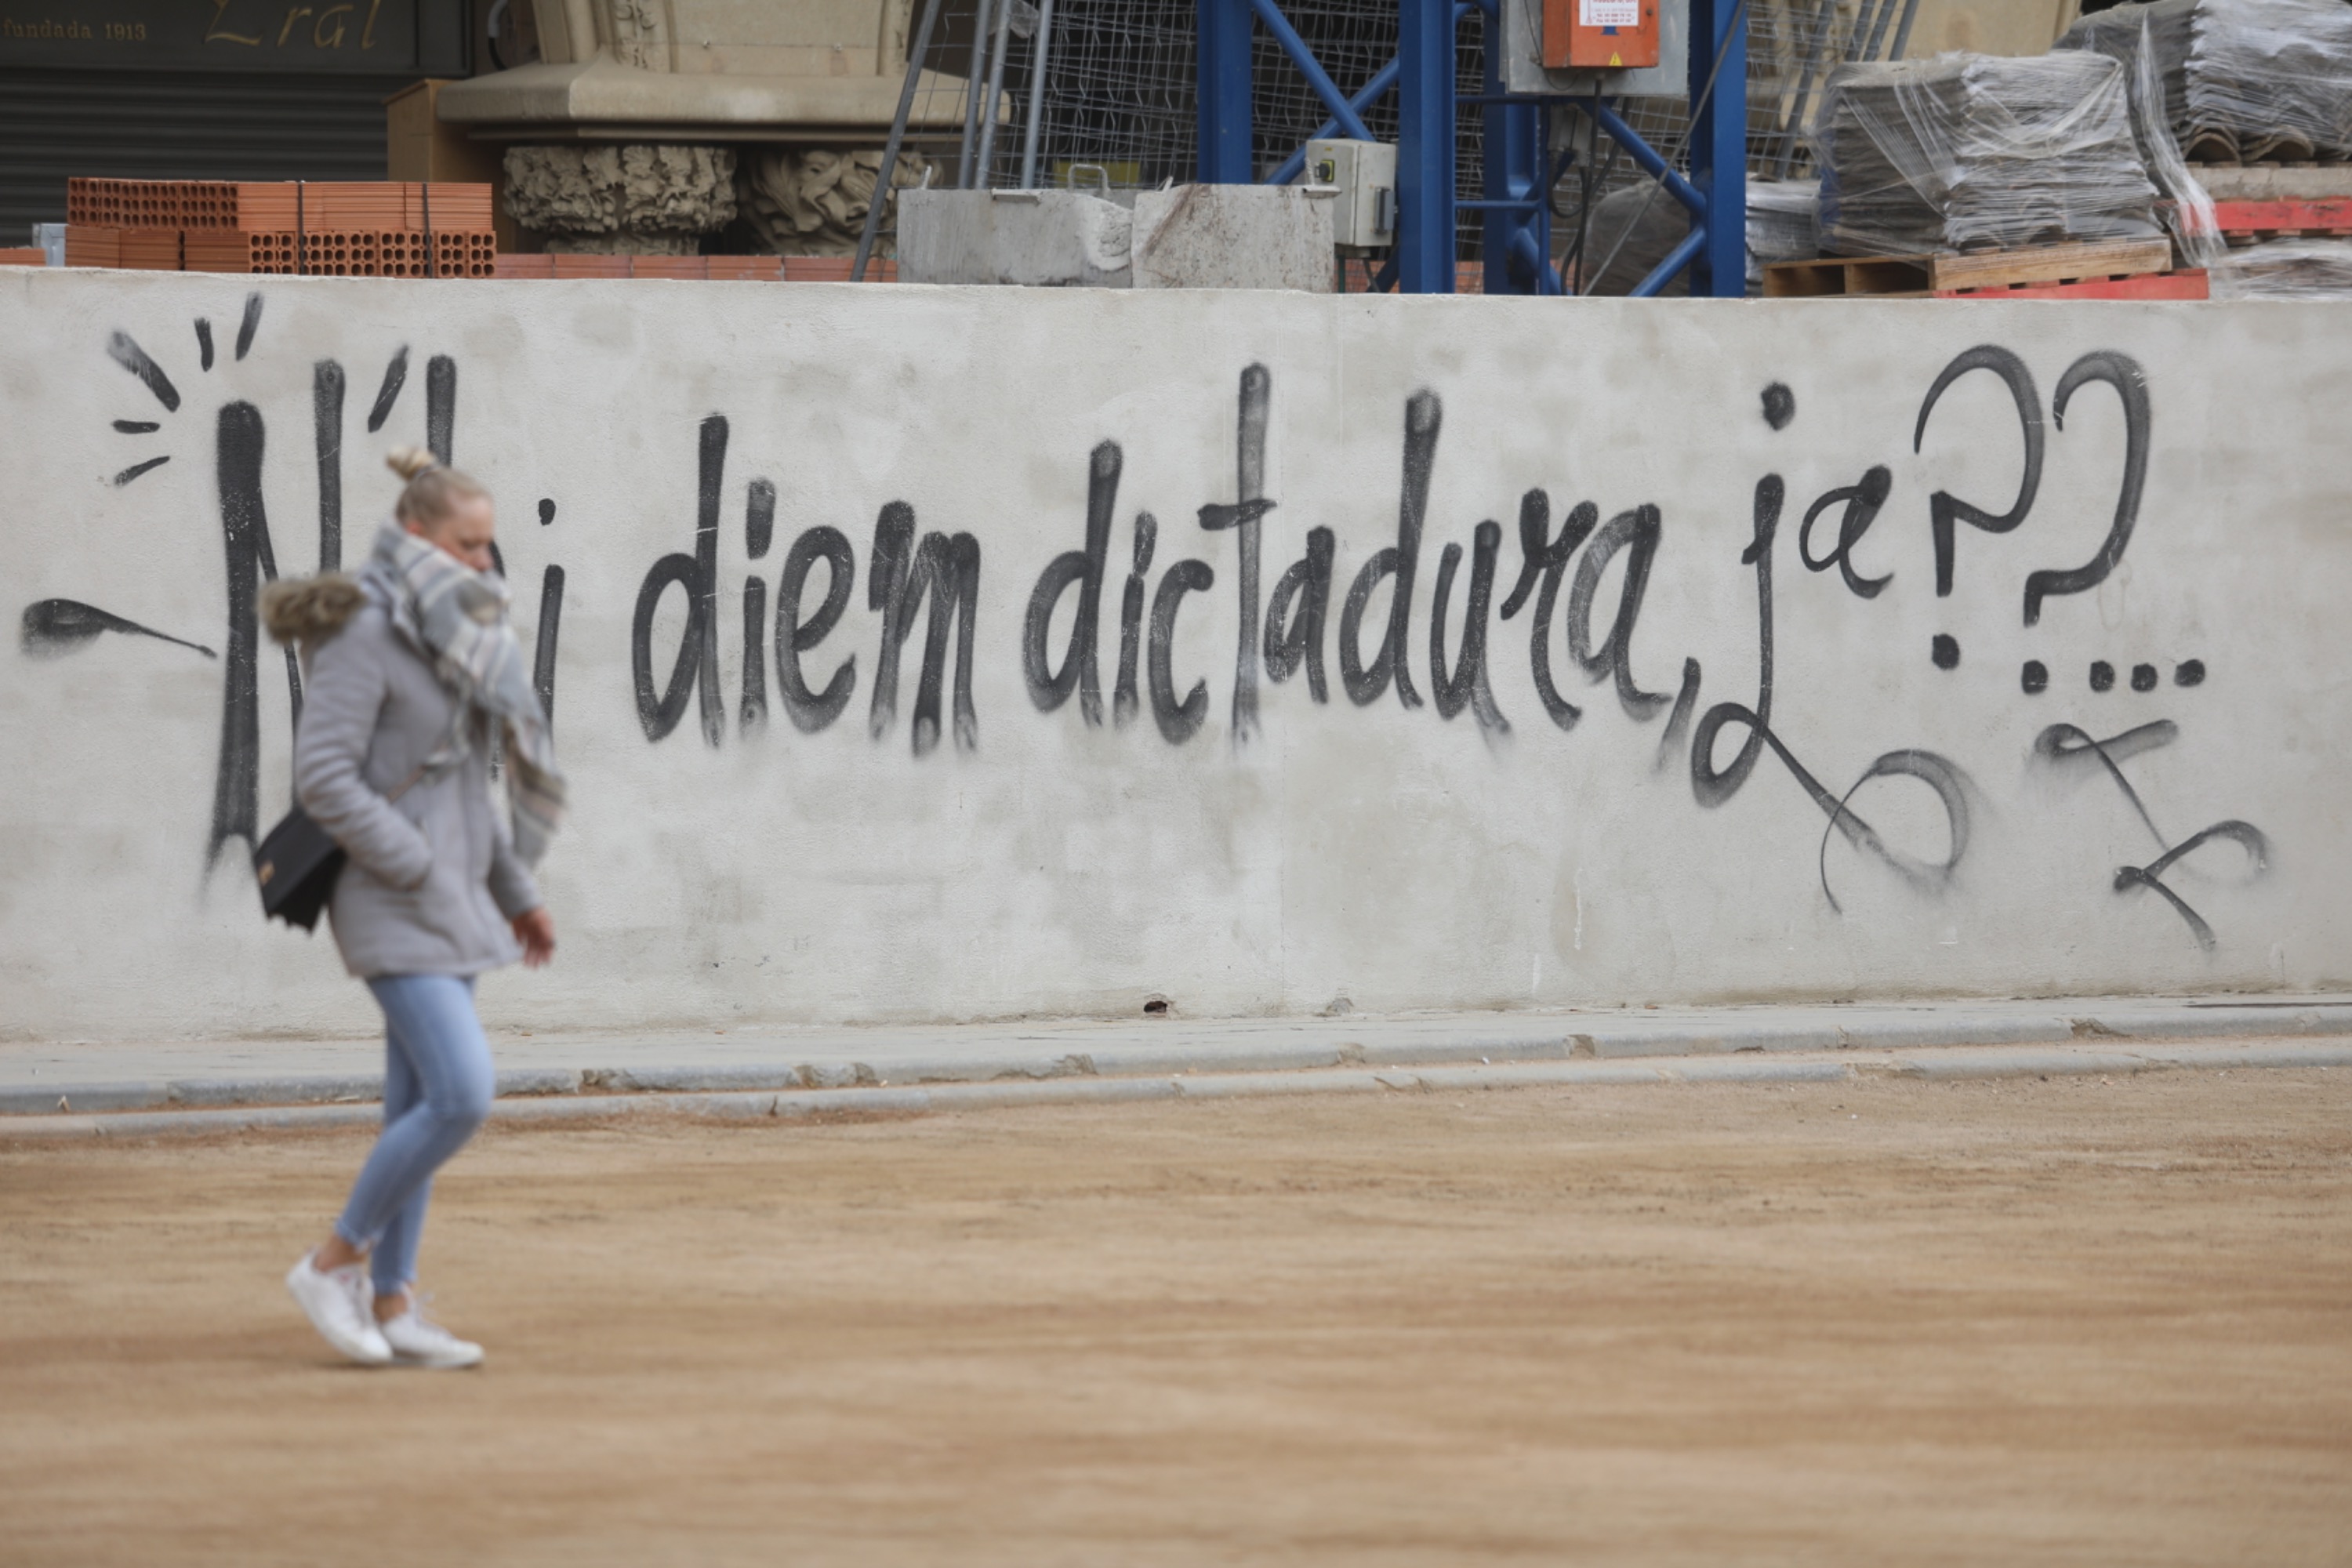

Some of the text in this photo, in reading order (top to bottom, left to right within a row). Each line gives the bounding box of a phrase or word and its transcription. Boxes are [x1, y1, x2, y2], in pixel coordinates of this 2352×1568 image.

[3, 18, 147, 41] fundada 1913
[632, 411, 980, 757] diem
